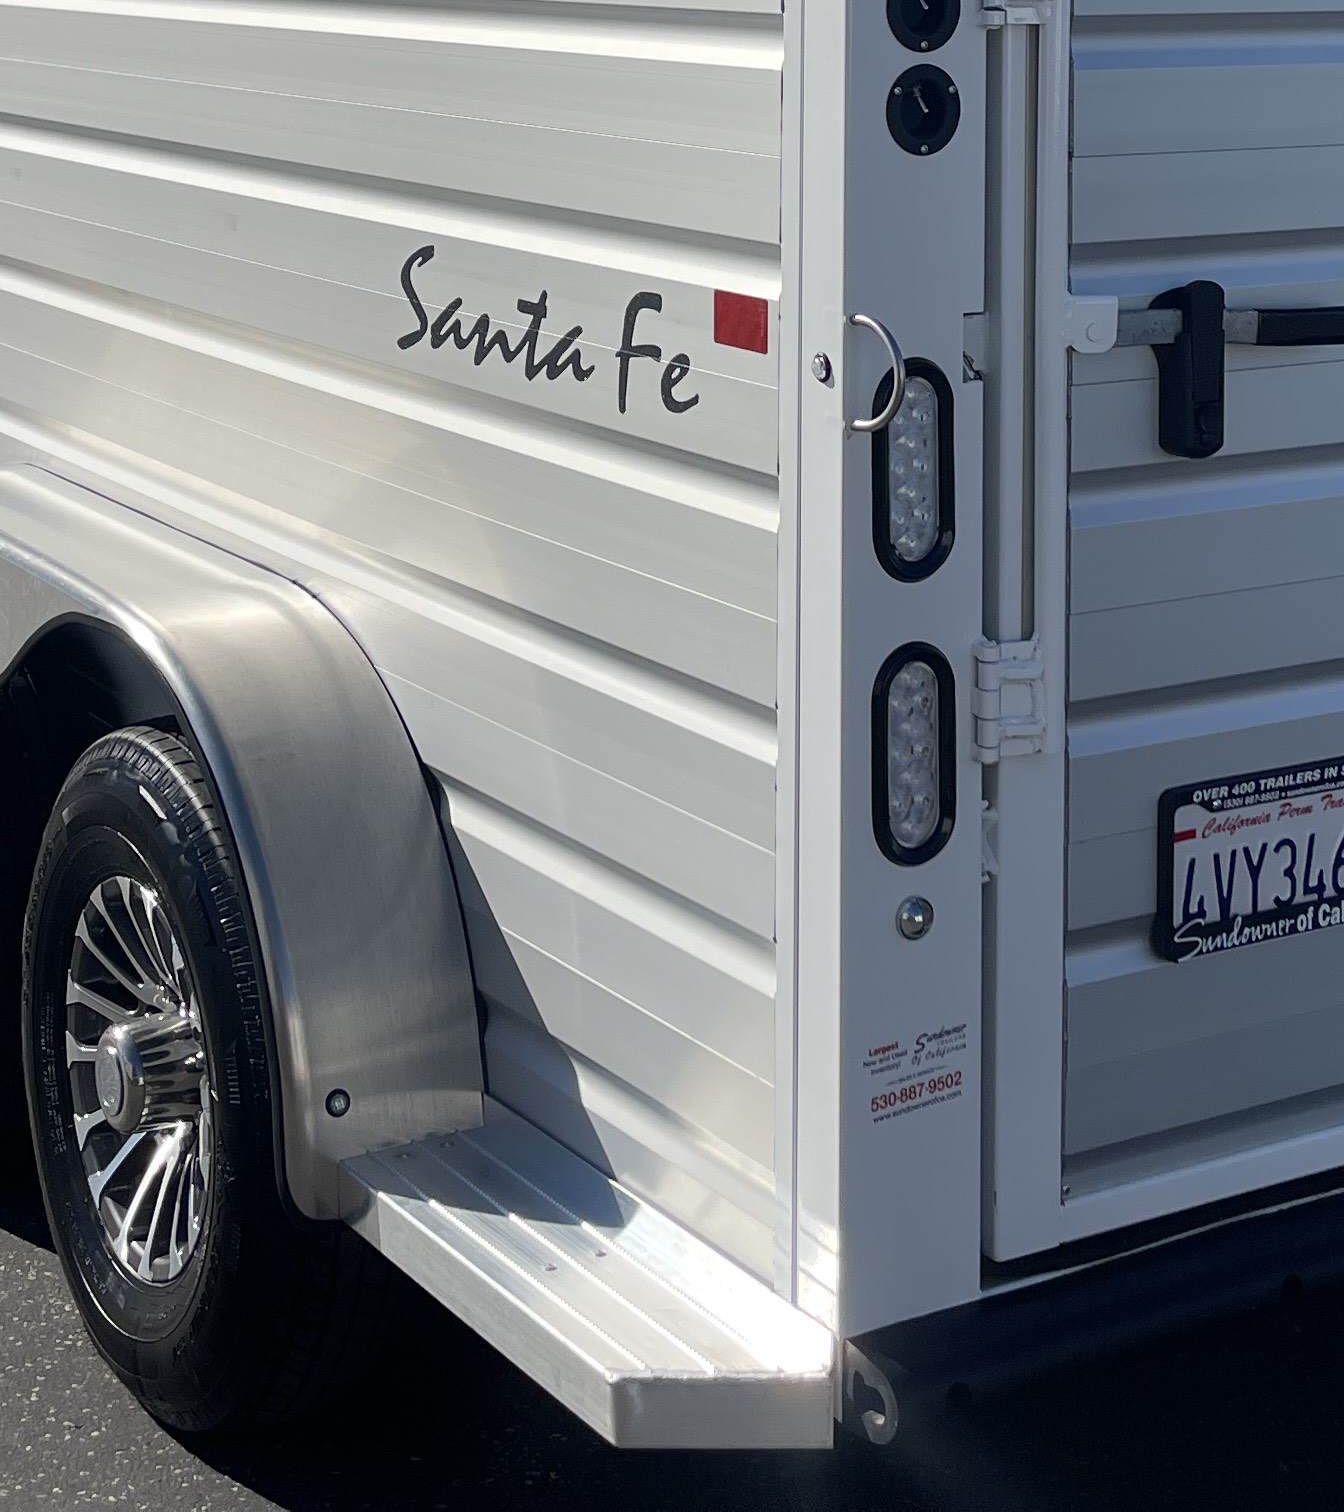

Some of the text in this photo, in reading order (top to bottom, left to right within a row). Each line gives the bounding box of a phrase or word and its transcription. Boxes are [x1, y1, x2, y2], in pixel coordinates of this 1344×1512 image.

[396, 244, 700, 415] Santa Fe
[1192, 786, 1229, 803] OVER
[1231, 780, 1256, 795] 400
[1258, 768, 1321, 792] TRAILERS
[1323, 765, 1339, 780] IN
[1201, 811, 1272, 840] California
[1276, 801, 1314, 822] Perm
[1173, 915, 1297, 964] Sundowner
[1296, 910, 1316, 933] of
[868, 1042, 899, 1057] Largest
